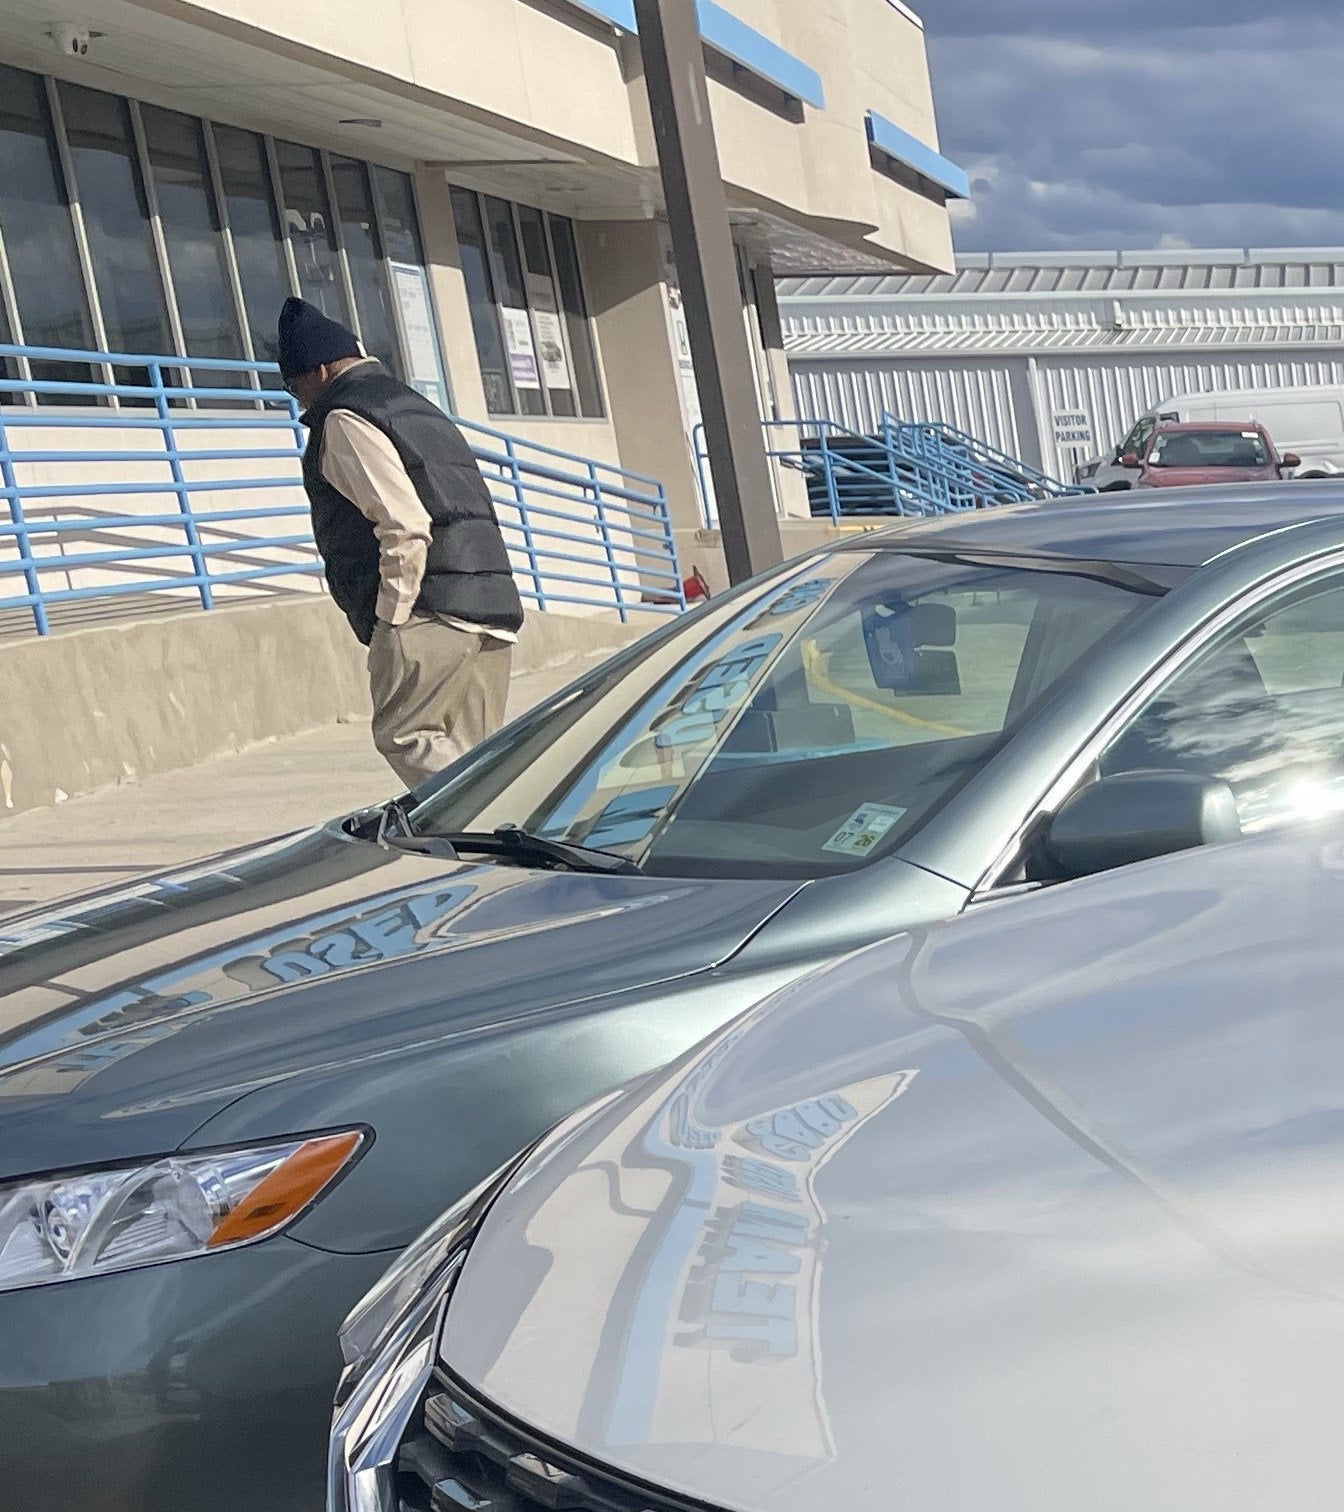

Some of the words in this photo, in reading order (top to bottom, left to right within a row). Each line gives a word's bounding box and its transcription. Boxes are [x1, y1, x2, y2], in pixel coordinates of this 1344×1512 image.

[1054, 414, 1087, 426] VISITOR
[1056, 430, 1090, 442] PARKING
[833, 831, 855, 843] 07
